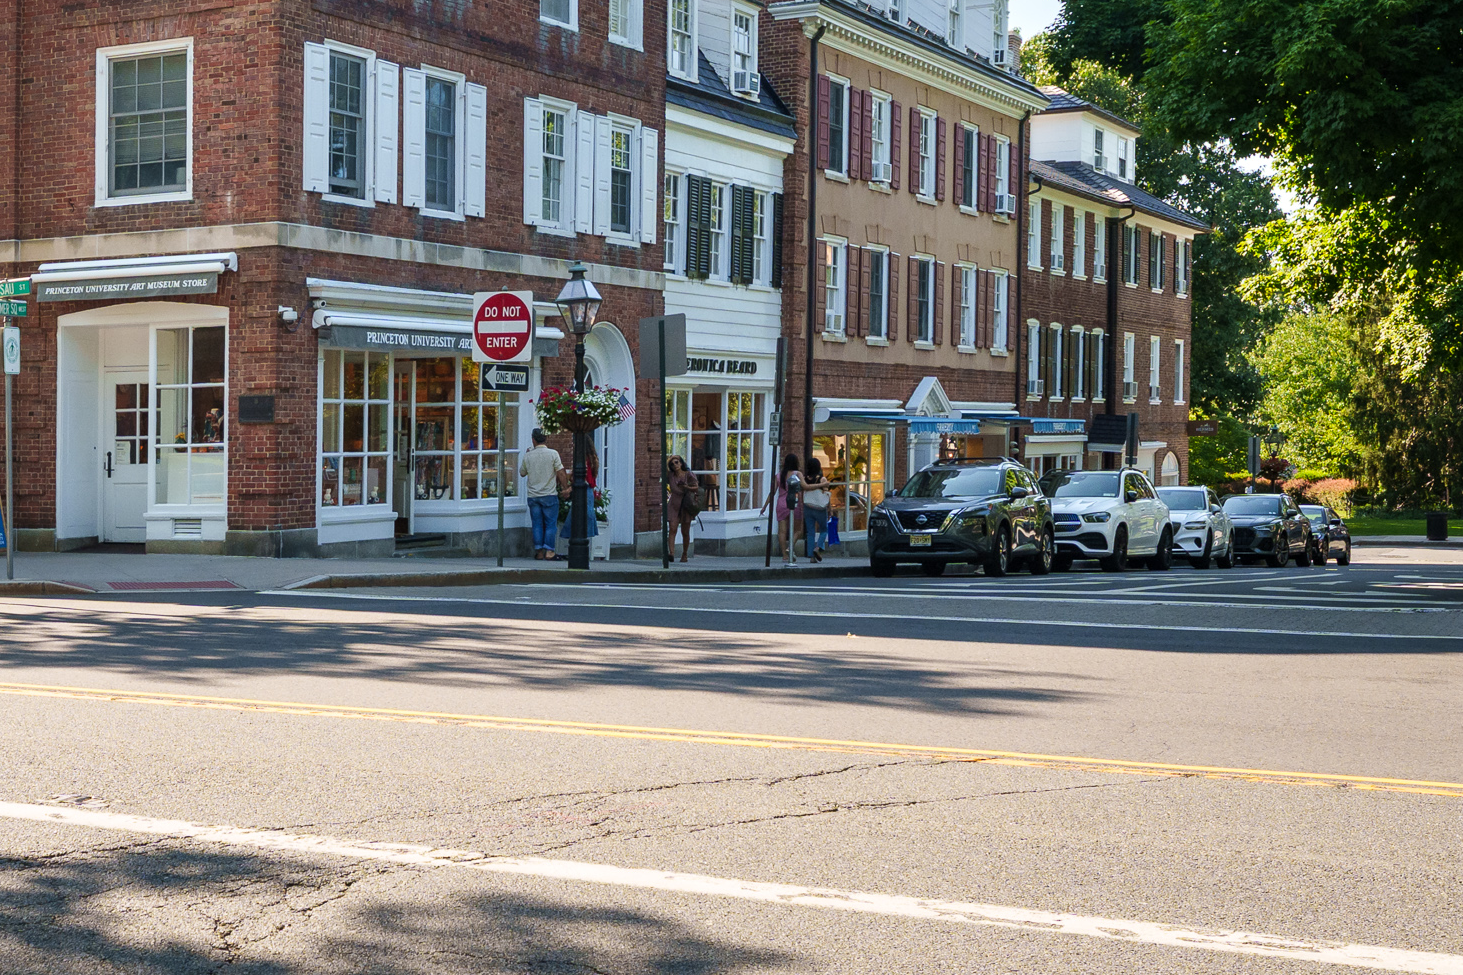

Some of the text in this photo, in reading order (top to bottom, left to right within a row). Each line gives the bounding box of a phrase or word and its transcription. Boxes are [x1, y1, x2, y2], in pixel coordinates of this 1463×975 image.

[45, 278, 208, 295] PRINCETON UNIVERSITY ART MUSEUM STORE
[10, 303, 18, 315] SQ
[484, 306, 521, 318] DO NOT
[366, 332, 410, 345] PRINCETON
[411, 335, 457, 348] UNIVERSITY
[486, 337, 518, 348] ENTER
[686, 358, 757, 374] ERONICA BEARD
[495, 372, 524, 383] ONE WAY
